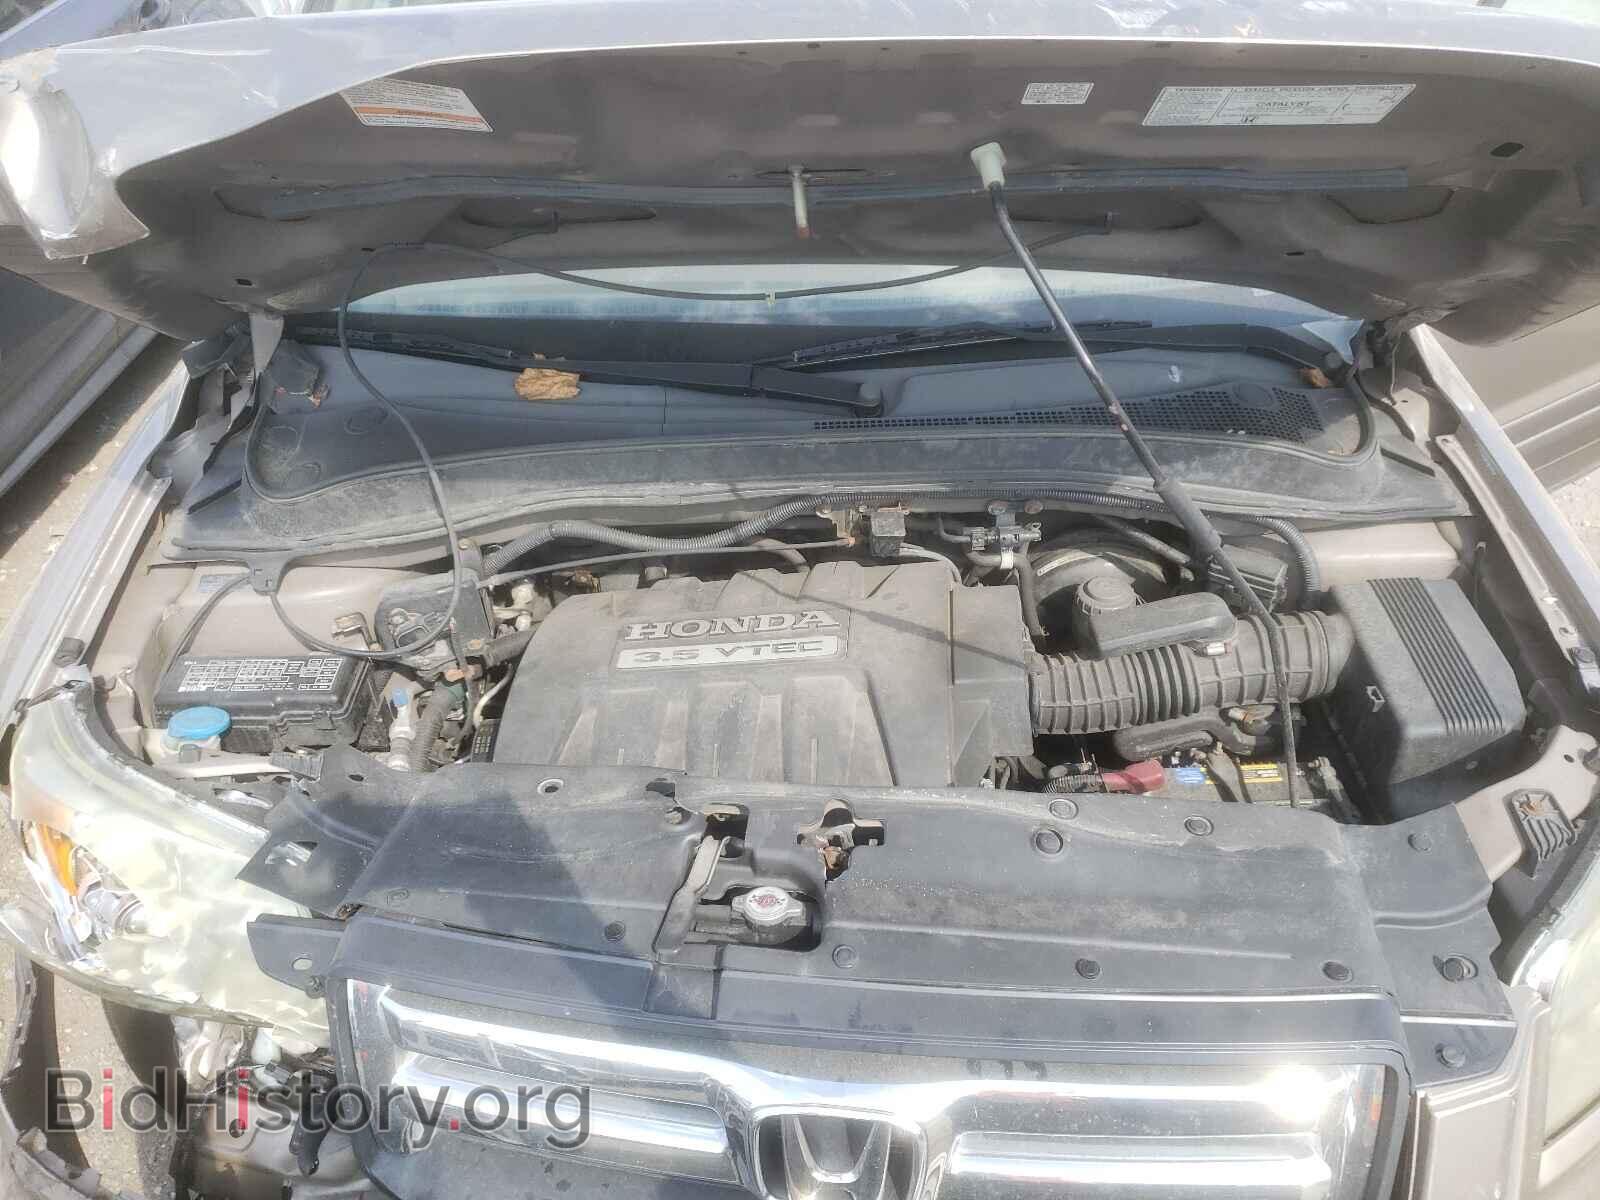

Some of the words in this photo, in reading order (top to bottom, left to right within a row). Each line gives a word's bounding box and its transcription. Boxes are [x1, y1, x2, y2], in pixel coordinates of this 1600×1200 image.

[624, 610, 840, 640] HONDA
[633, 649, 700, 663] 3.5
[715, 640, 825, 657] VTEC
